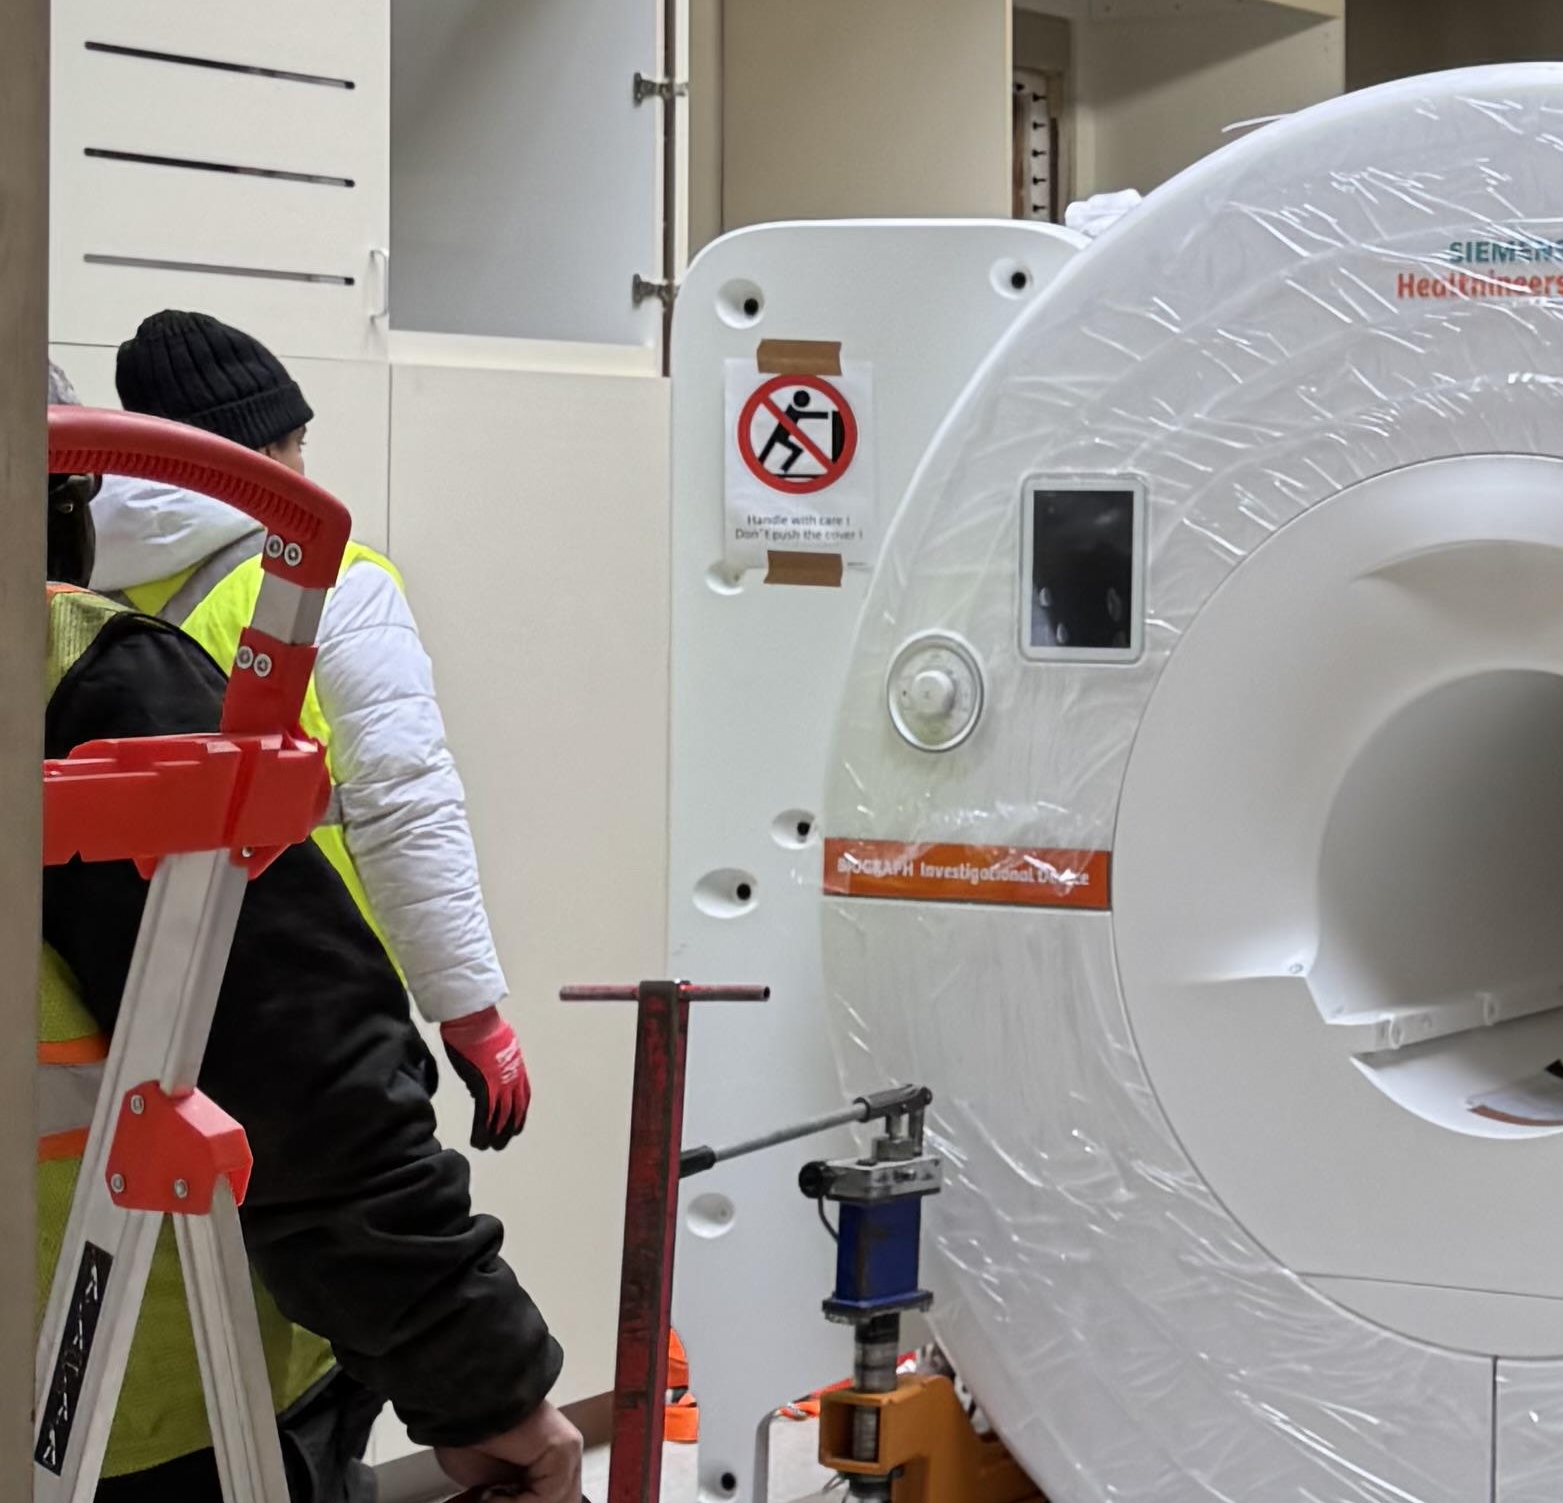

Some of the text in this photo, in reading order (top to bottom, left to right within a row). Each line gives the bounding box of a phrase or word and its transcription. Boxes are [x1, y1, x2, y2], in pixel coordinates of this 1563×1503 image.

[747, 514, 787, 526] Handle
[791, 514, 816, 526] with
[819, 516, 843, 526] care
[772, 529, 800, 542] push
[803, 529, 822, 540] the
[825, 531, 855, 541] cover
